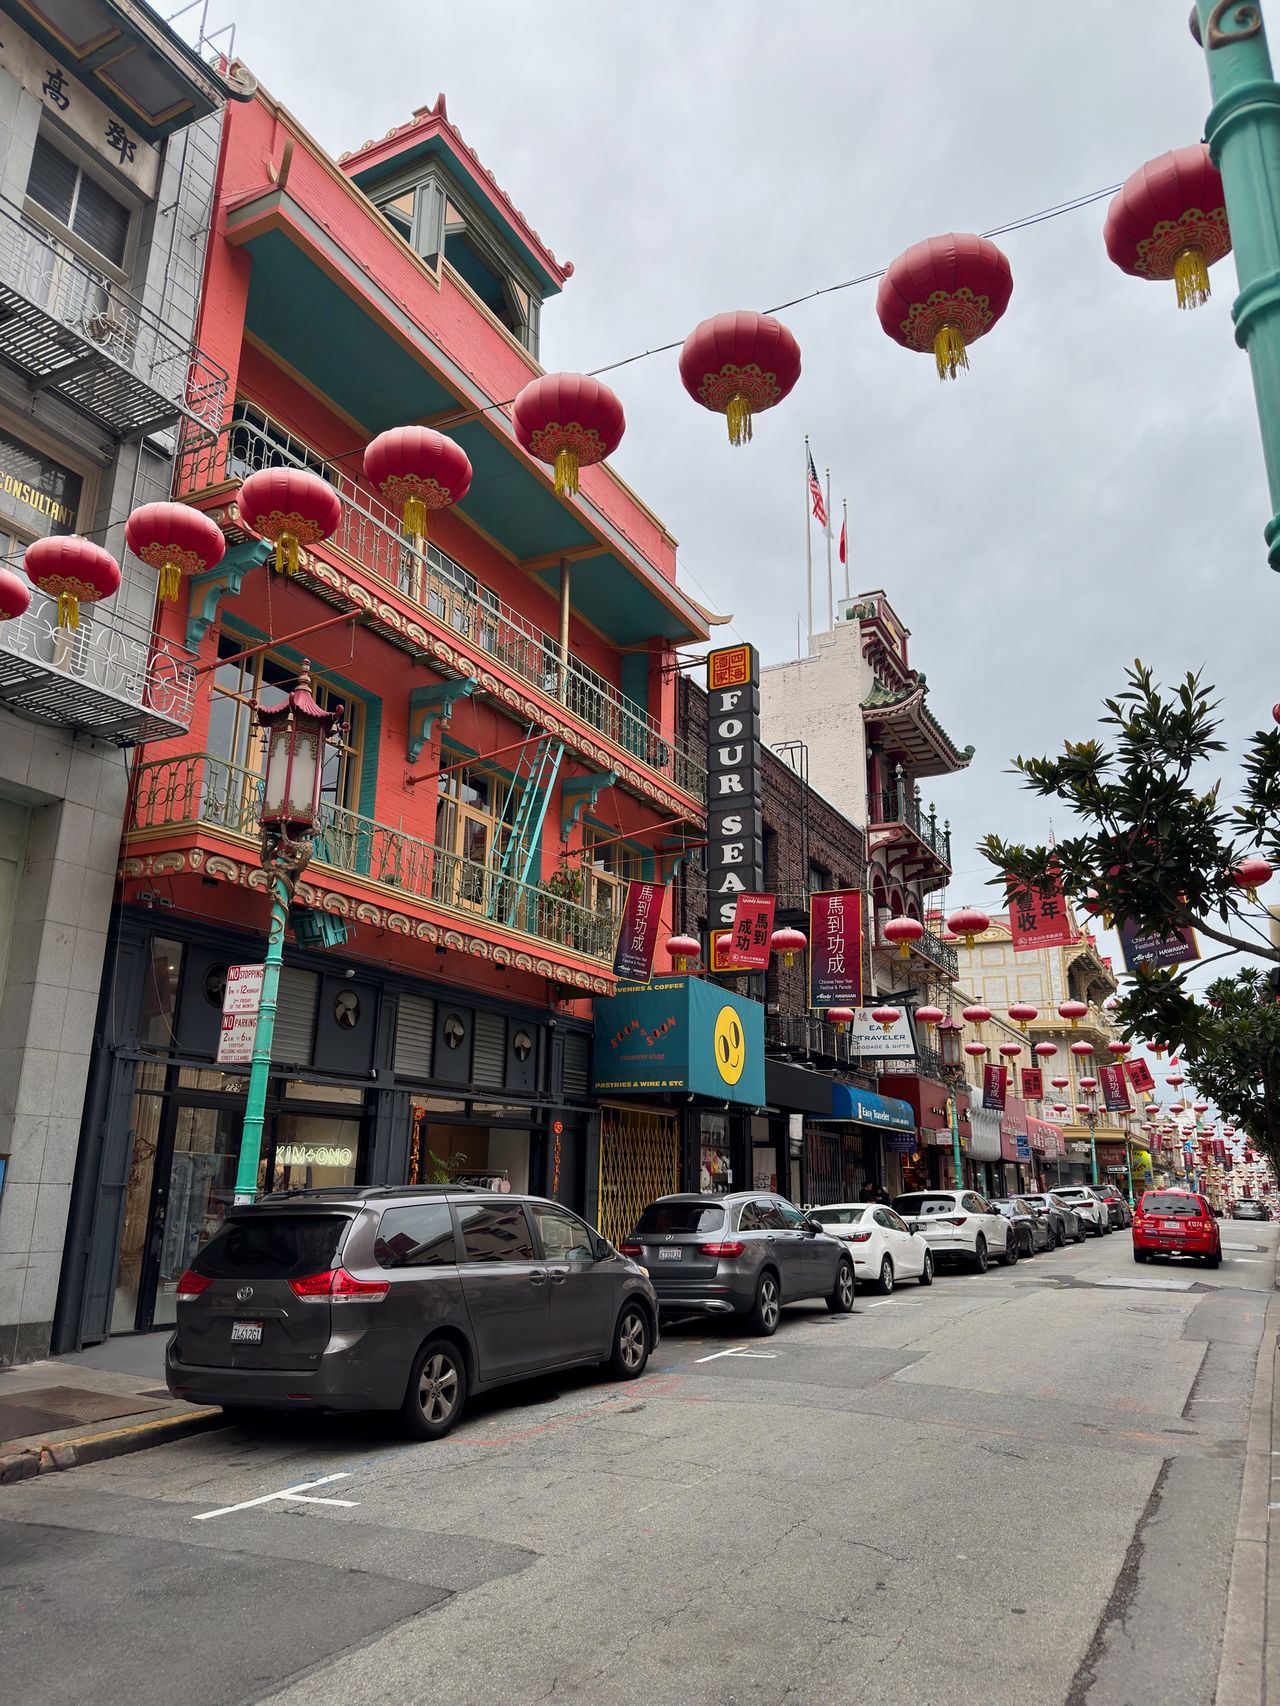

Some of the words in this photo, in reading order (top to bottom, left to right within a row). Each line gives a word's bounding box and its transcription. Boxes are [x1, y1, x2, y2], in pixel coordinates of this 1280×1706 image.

[718, 690, 744, 795] FOUR
[717, 815, 746, 923] SEAS
[742, 896, 756, 905] Speedy
[756, 898, 771, 906] Success
[631, 885, 654, 952] 馬到功成
[736, 918, 752, 951] 成功
[754, 912, 769, 947] 馬到
[827, 896, 845, 974] 馬到功成
[1158, 944, 1189, 956] HAWAIIAN
[229, 967, 240, 981] NO
[239, 970, 264, 980] STOPPING
[615, 984, 645, 993] VENIRS
[654, 983, 685, 991] COFFEE
[223, 1015, 233, 1029] NO
[234, 1018, 257, 1028] PARKING
[649, 1052, 666, 1062] shop
[862, 1106, 873, 1120] Easy
[873, 1109, 890, 1122] Traveler
